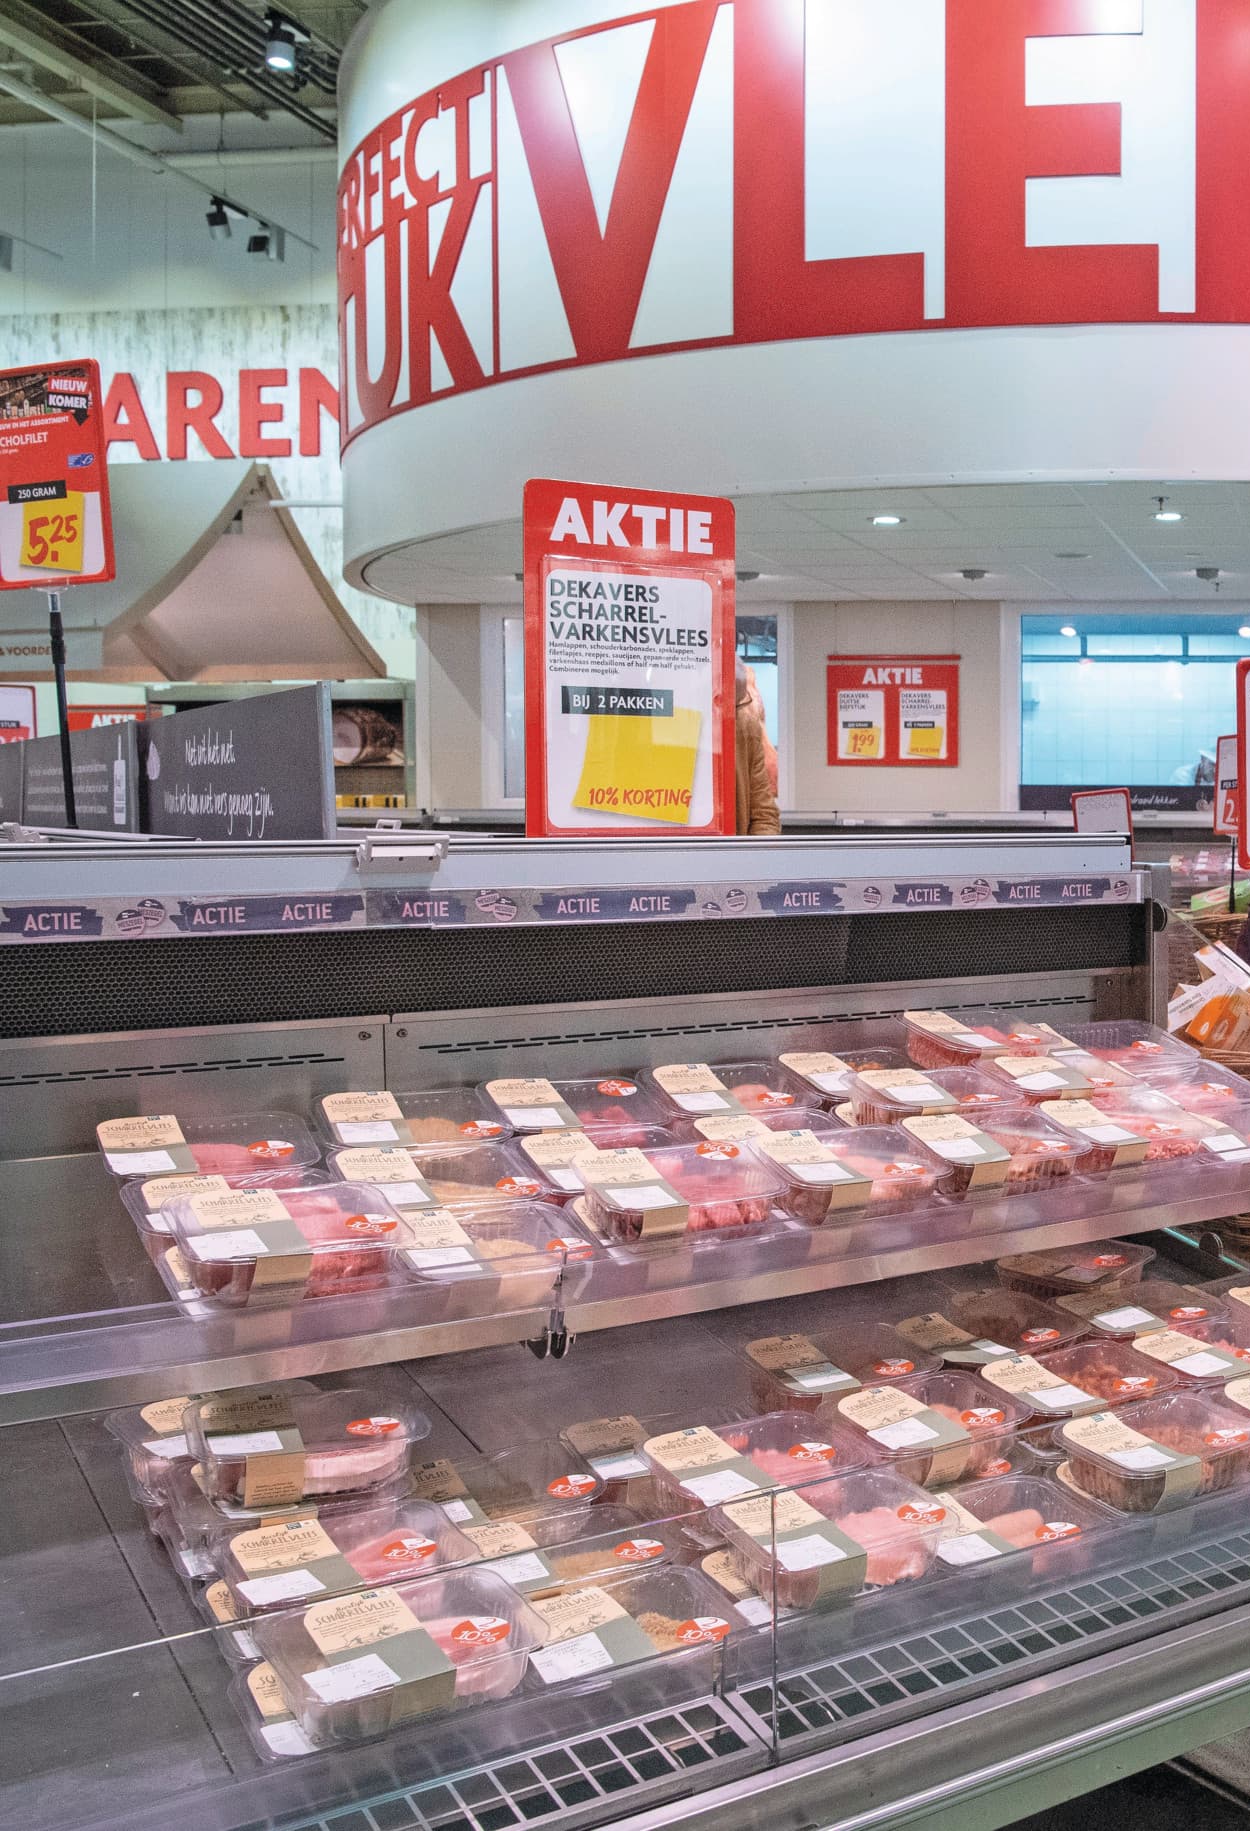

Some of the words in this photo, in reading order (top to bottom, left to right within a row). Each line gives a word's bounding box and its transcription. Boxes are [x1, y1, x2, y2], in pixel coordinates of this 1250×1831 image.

[51, 378, 88, 393] NIEUW
[48, 394, 88, 410] KOMER
[17, 488, 32, 500] 250
[33, 485, 57, 498] GRAM
[549, 497, 714, 555] AKTIE
[27, 513, 79, 565] 5.25
[550, 578, 660, 604] DEKAVERS
[550, 600, 667, 624] SCHARREL-
[549, 621, 709, 648] VARKENSVLEES
[862, 667, 924, 685] AKTIE
[572, 694, 590, 708] BIJ
[597, 695, 607, 708] 2
[609, 696, 665, 709] PAKKEN
[589, 786, 620, 807] 10%
[623, 788, 693, 808] KORTING
[907, 888, 941, 903] ACTIE
[1009, 885, 1041, 900] ACTIE
[1061, 883, 1092, 898] ACTIE
[557, 898, 600, 914] ACTIE
[629, 896, 671, 912] ACTIE
[783, 891, 821, 907] ACTIE
[193, 906, 246, 926] ACTIE
[282, 903, 333, 921] ACTIE
[402, 901, 449, 918] ACTIE
[24, 912, 82, 932] ACTIE
[452, 1629, 497, 1645] 10%
